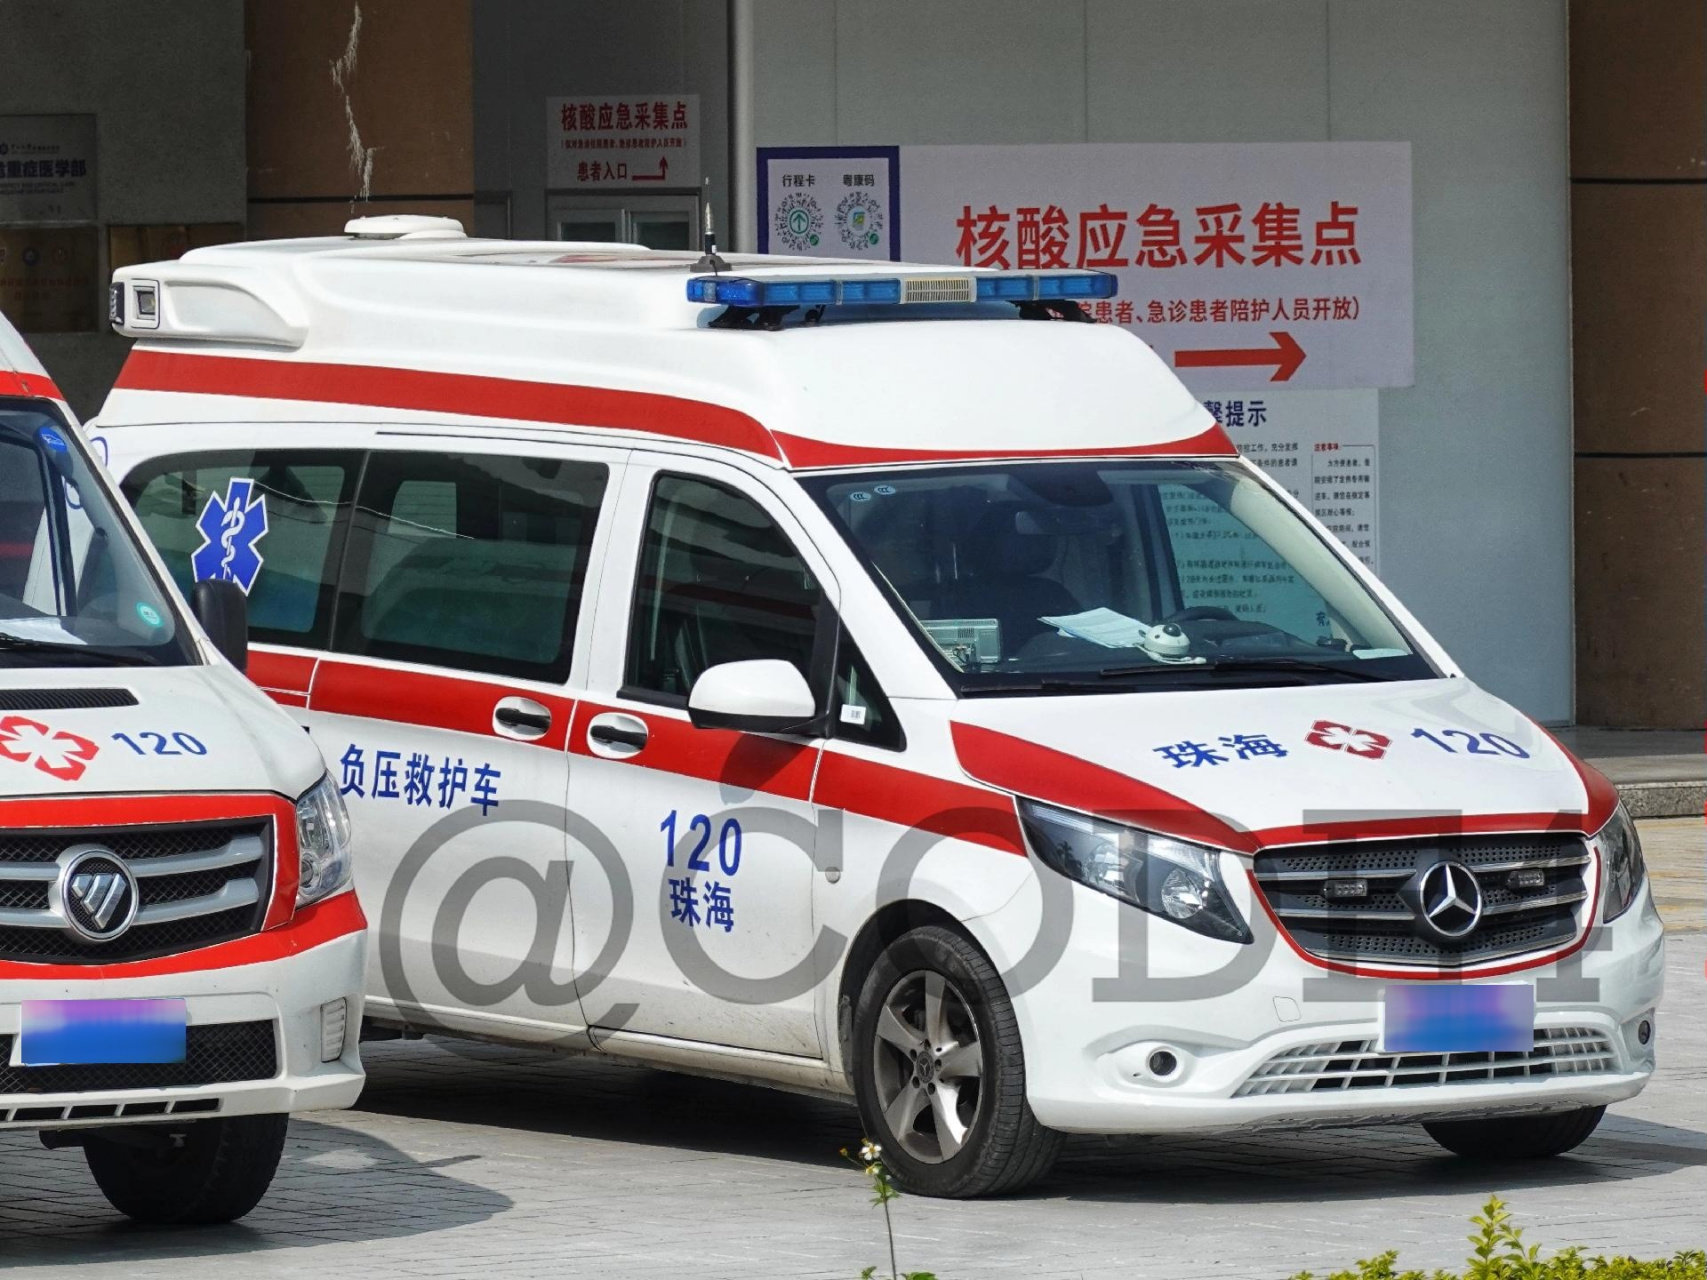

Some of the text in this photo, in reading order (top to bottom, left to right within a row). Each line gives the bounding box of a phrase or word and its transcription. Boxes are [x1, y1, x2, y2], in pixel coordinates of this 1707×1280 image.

[561, 101, 688, 131] 核酸应急采集点
[577, 160, 627, 182] 患者入口
[782, 173, 816, 188] 行程卡
[843, 173, 875, 187] 粤康码
[956, 200, 1361, 271] 核酸应急采集点
[110, 731, 208, 757] 120
[1152, 732, 1290, 770] 珠海
[1411, 726, 1531, 760] 120
[341, 744, 501, 816] 负压救护车
[660, 809, 742, 877] 120
[668, 876, 735, 933] 珠海
